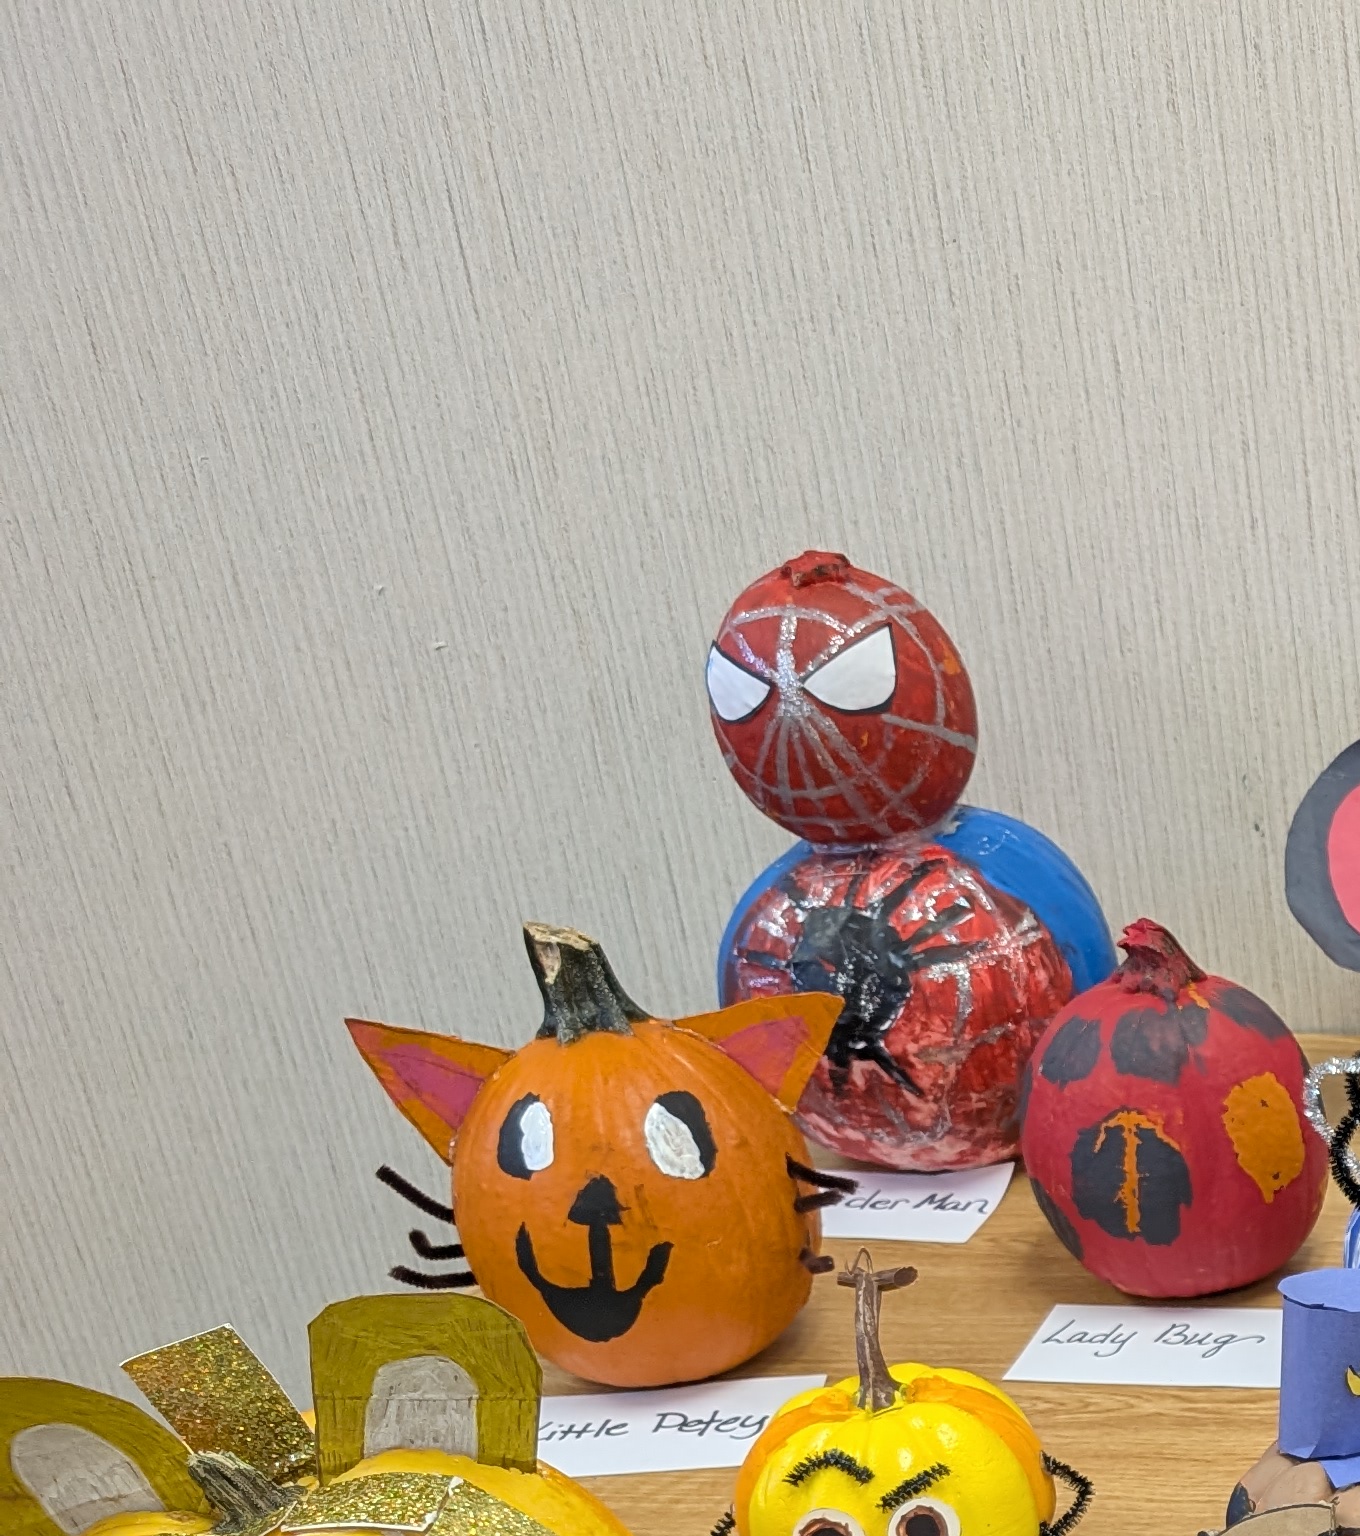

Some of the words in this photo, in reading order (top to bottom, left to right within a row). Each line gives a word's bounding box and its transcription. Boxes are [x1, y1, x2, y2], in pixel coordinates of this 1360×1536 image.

[844, 1189, 910, 1211] der
[913, 1193, 990, 1215] Man
[1041, 1319, 1138, 1358] Lady
[1153, 1323, 1265, 1359] Bug
[652, 1410, 770, 1441] Petey
